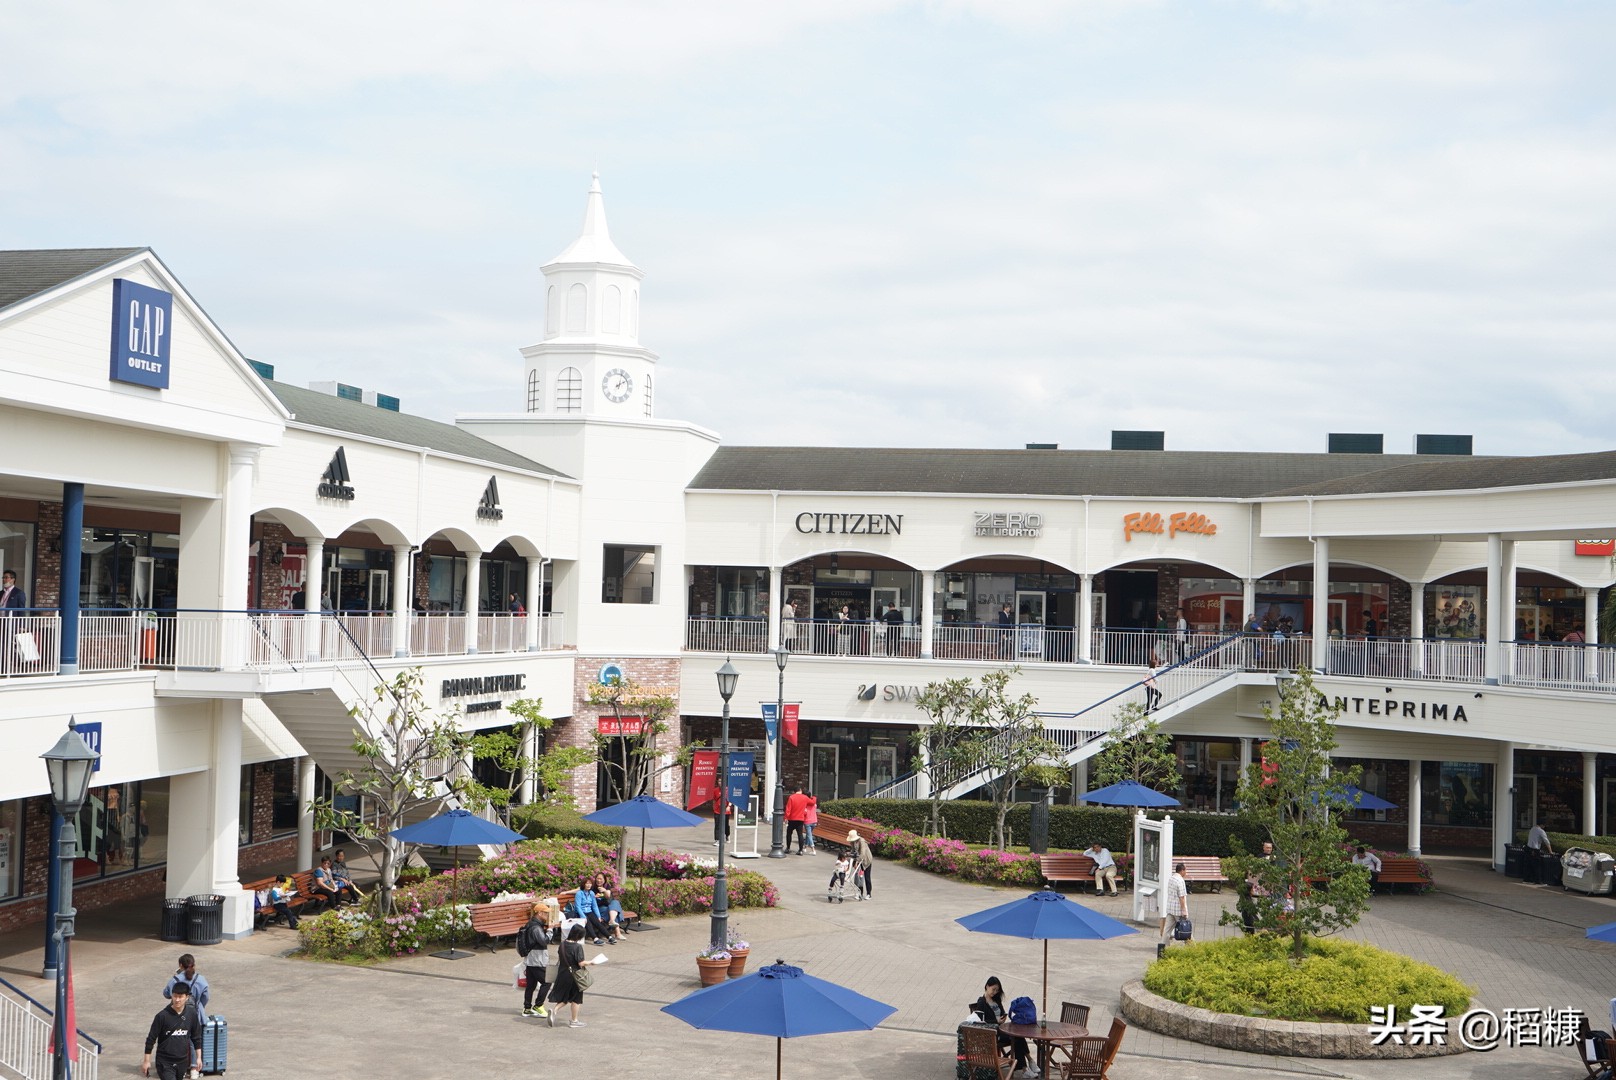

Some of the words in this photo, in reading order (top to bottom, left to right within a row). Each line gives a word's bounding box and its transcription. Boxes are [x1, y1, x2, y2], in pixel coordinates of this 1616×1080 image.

[129, 300, 164, 357] GAP
[128, 357, 162, 373] OUTLET
[795, 512, 904, 535] CITIZEN
[974, 511, 1043, 528] ZERO
[1124, 512, 1165, 542] Folli
[1169, 512, 1217, 539] Follie
[974, 527, 1042, 537] HALLIBURTON
[978, 593, 1014, 605] SALE
[442, 678, 483, 698] BANANA
[1318, 695, 1468, 722] ANTEPRIMA
